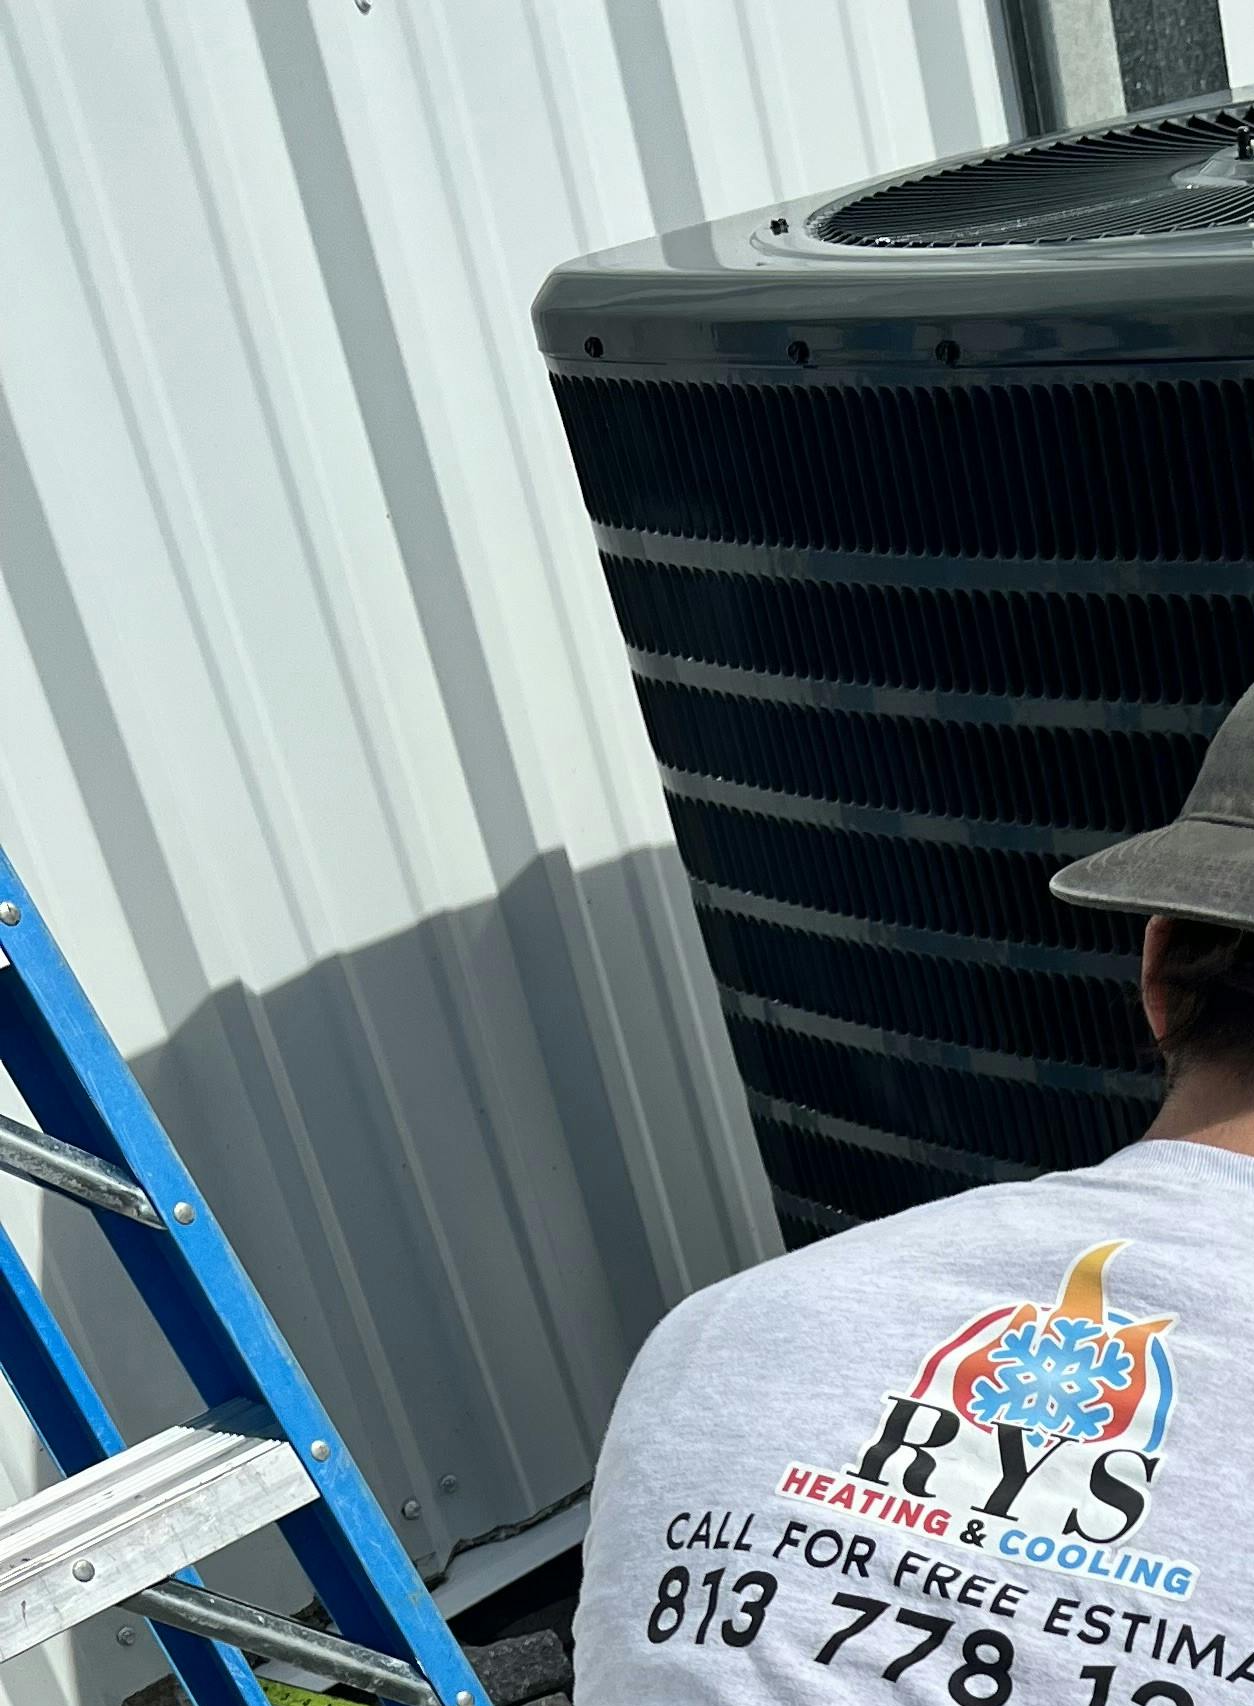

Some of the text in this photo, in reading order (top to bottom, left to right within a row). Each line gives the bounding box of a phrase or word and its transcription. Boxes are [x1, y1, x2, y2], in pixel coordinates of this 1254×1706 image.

[846, 1395, 1160, 1544] RYS
[666, 1511, 755, 1551] CALL
[772, 1521, 876, 1578] FOR
[893, 1551, 1029, 1618] FREE
[781, 1467, 1193, 1596] HEATING & COOLING
[647, 1566, 778, 1647] 813
